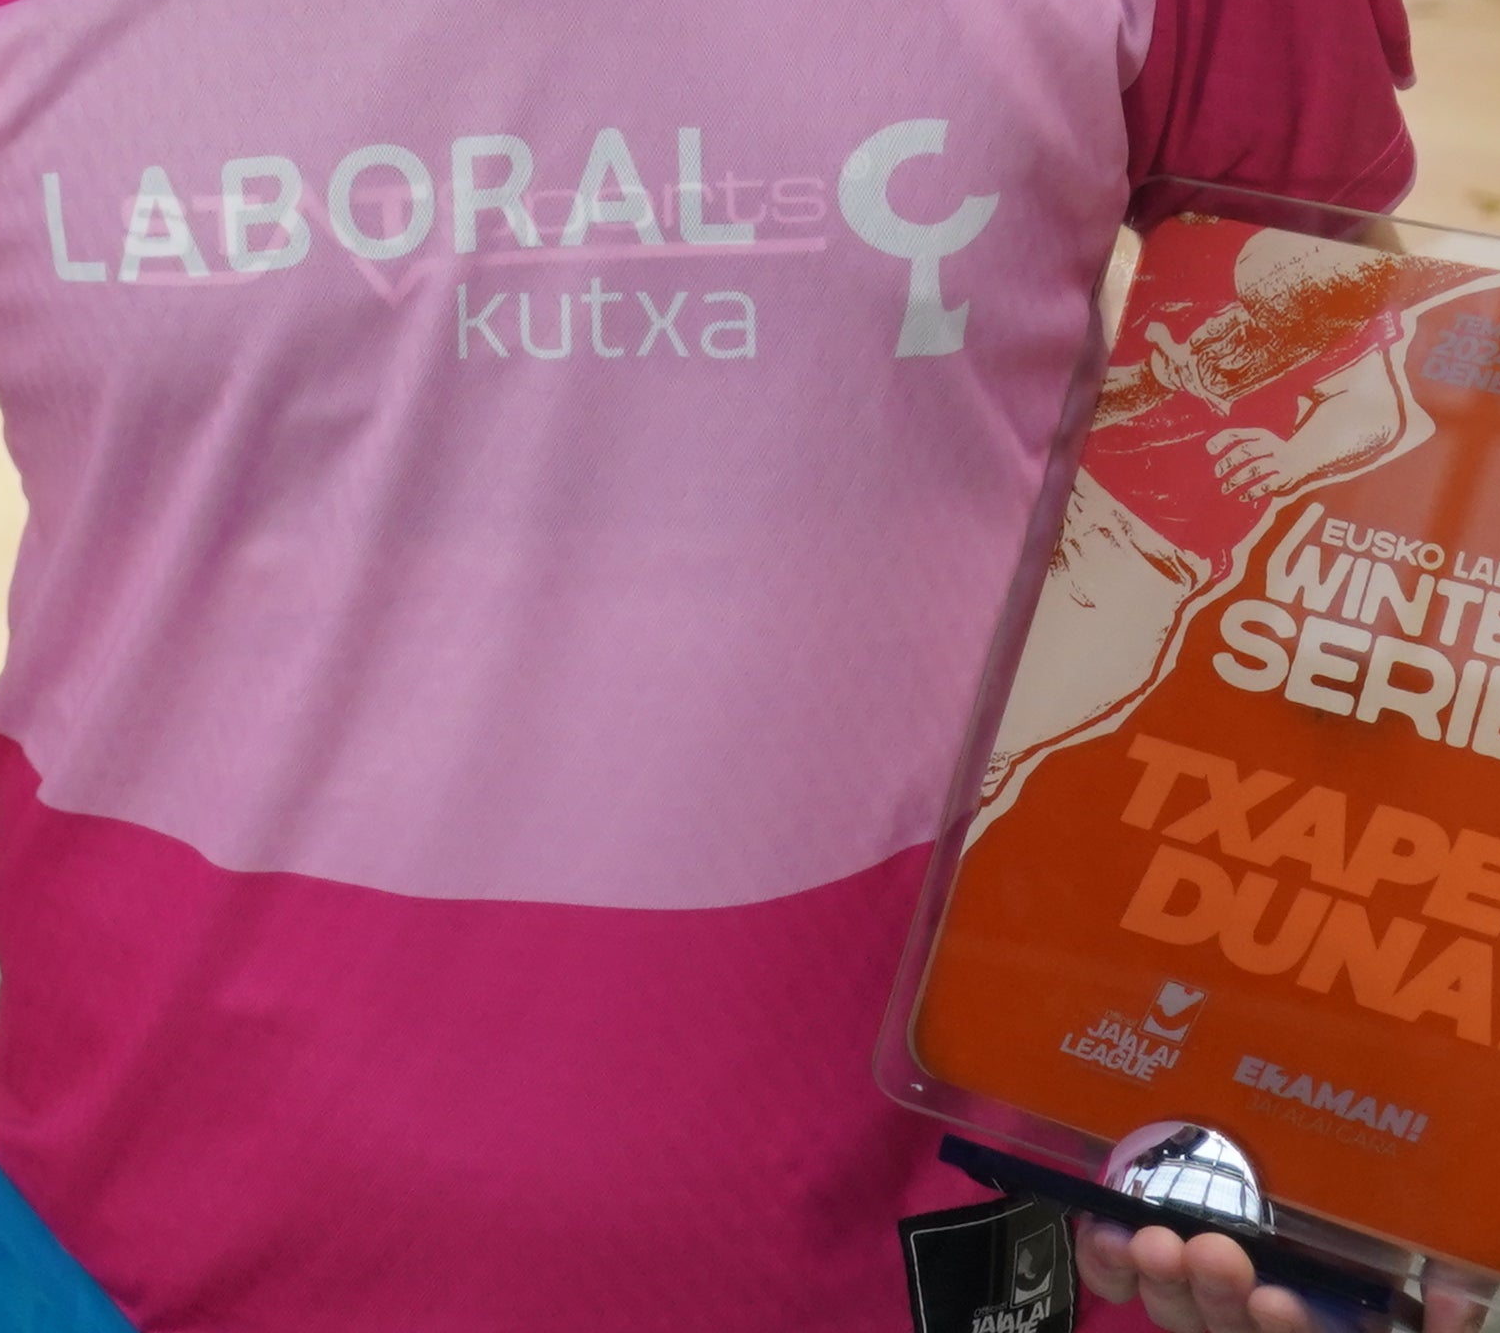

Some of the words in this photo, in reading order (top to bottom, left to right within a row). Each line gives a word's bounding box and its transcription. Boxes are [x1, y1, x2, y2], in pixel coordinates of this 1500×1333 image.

[41, 125, 756, 282] LABORAL
[456, 275, 757, 360] kutxa
[1321, 517, 1445, 570] EUSKO
[1059, 1032, 1152, 1082] LEAGUE
